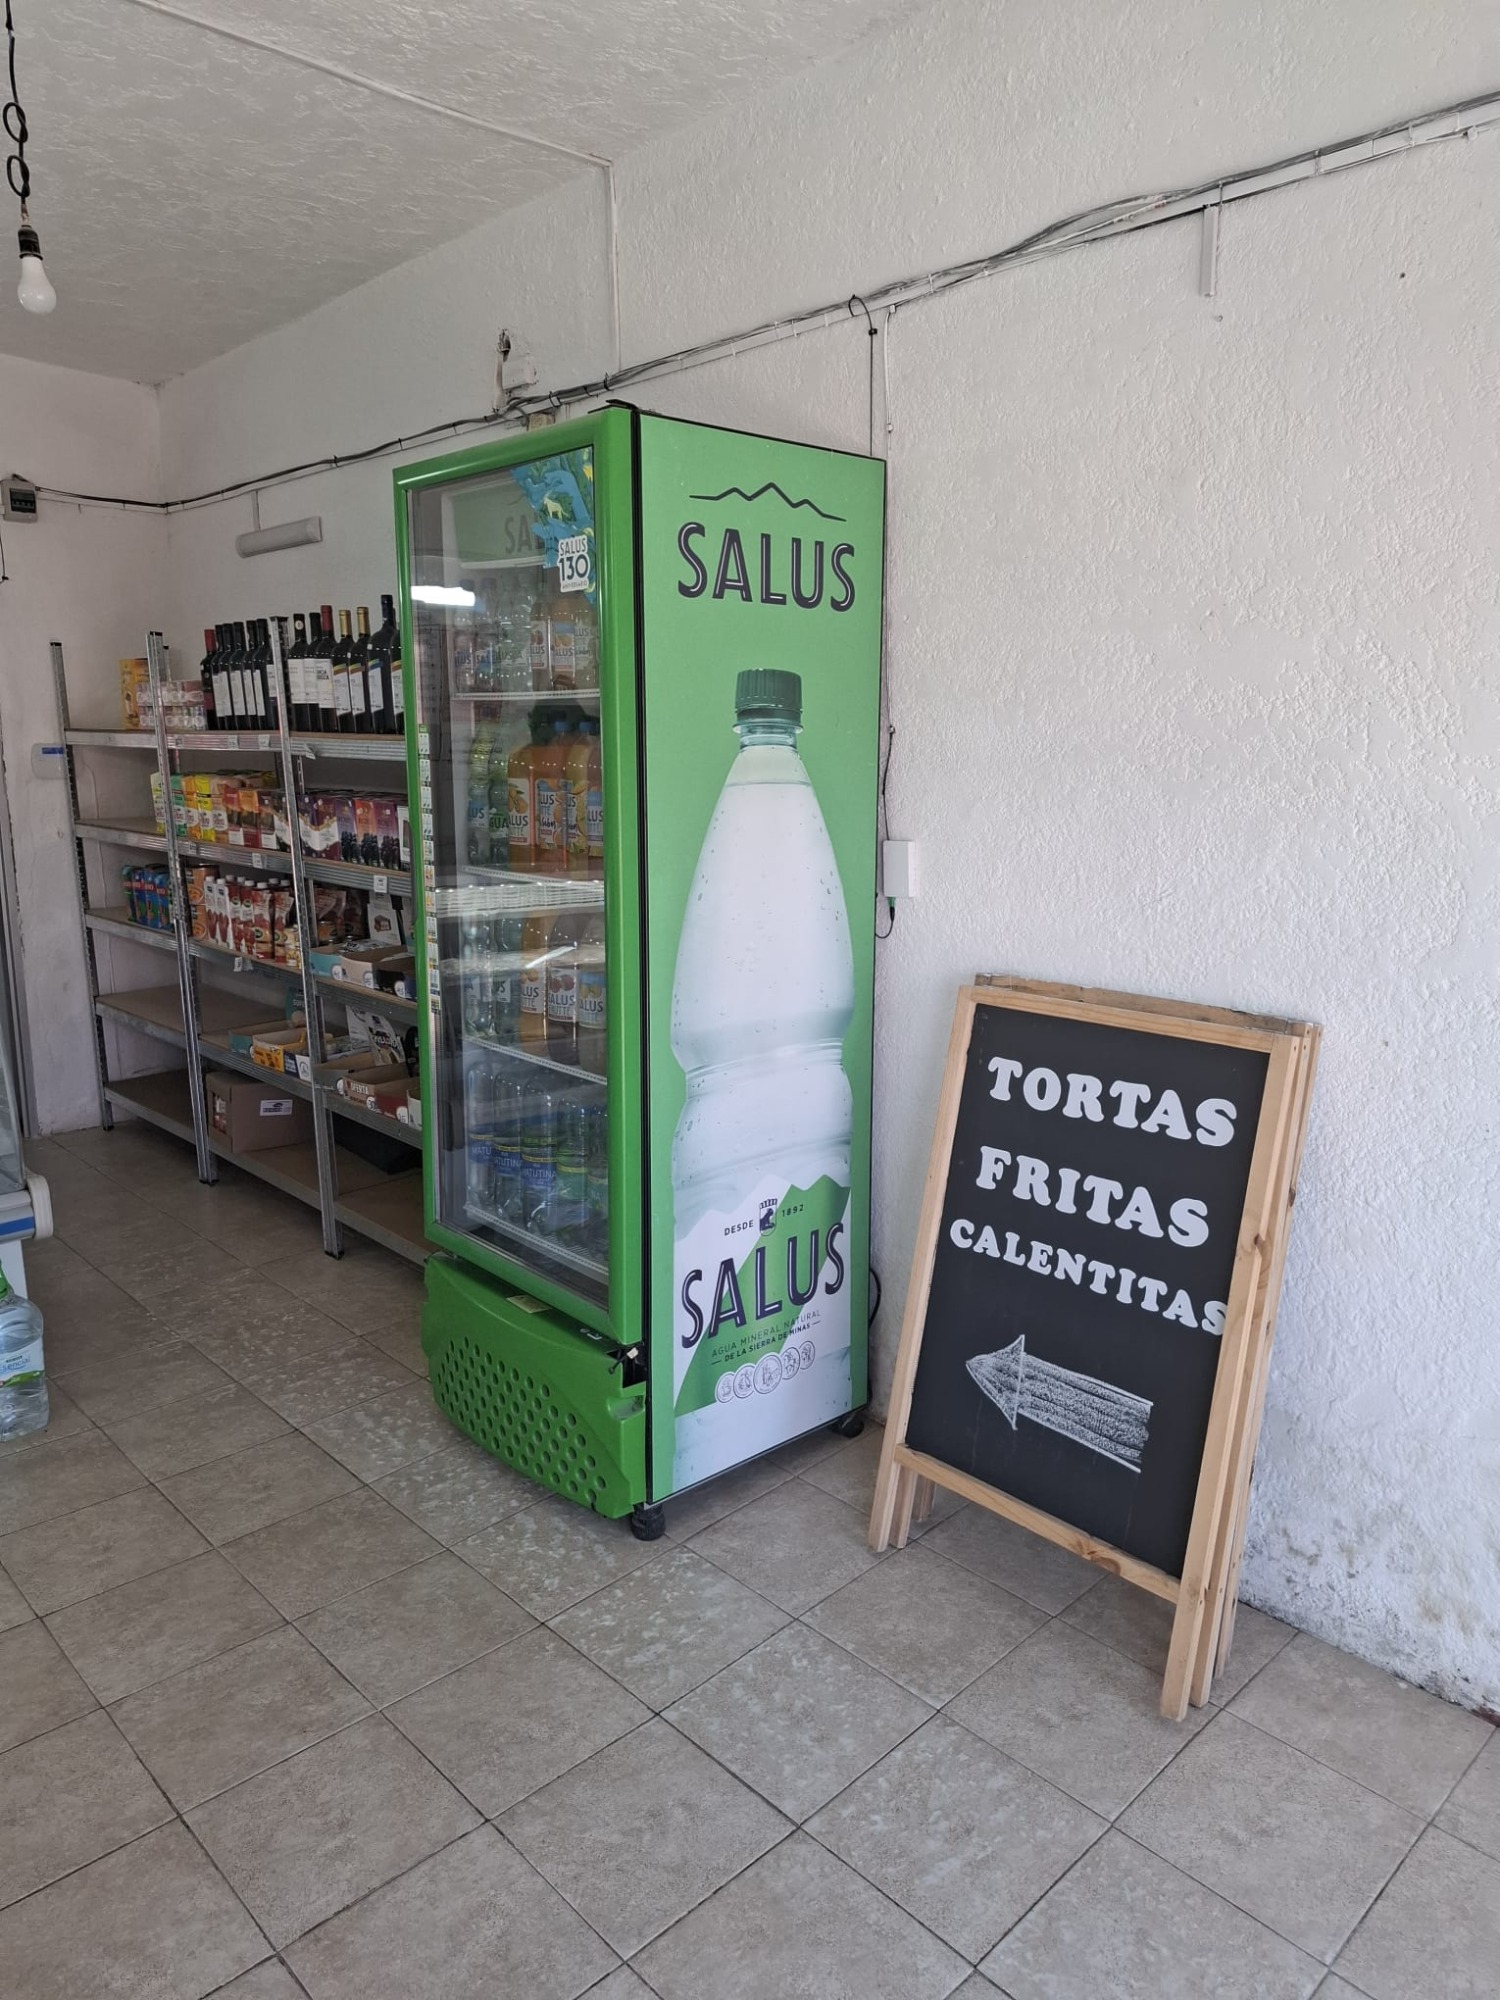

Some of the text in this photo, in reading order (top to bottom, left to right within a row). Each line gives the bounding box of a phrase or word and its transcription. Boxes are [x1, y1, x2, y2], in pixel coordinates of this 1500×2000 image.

[559, 554, 589, 581] 130
[560, 537, 587, 556] SALUS
[677, 521, 855, 612] SALUS
[988, 1056, 1238, 1147] TORTAS
[724, 1204, 804, 1236] DESDE 1892
[976, 1145, 1209, 1247] FRITAS
[682, 1222, 844, 1349] SALUS
[950, 1219, 1228, 1336] CALENTITAS
[711, 1309, 821, 1358] AGUA MINERAL NATURAL
[724, 1322, 811, 1362] DE LA SIERRA DE MINAS
